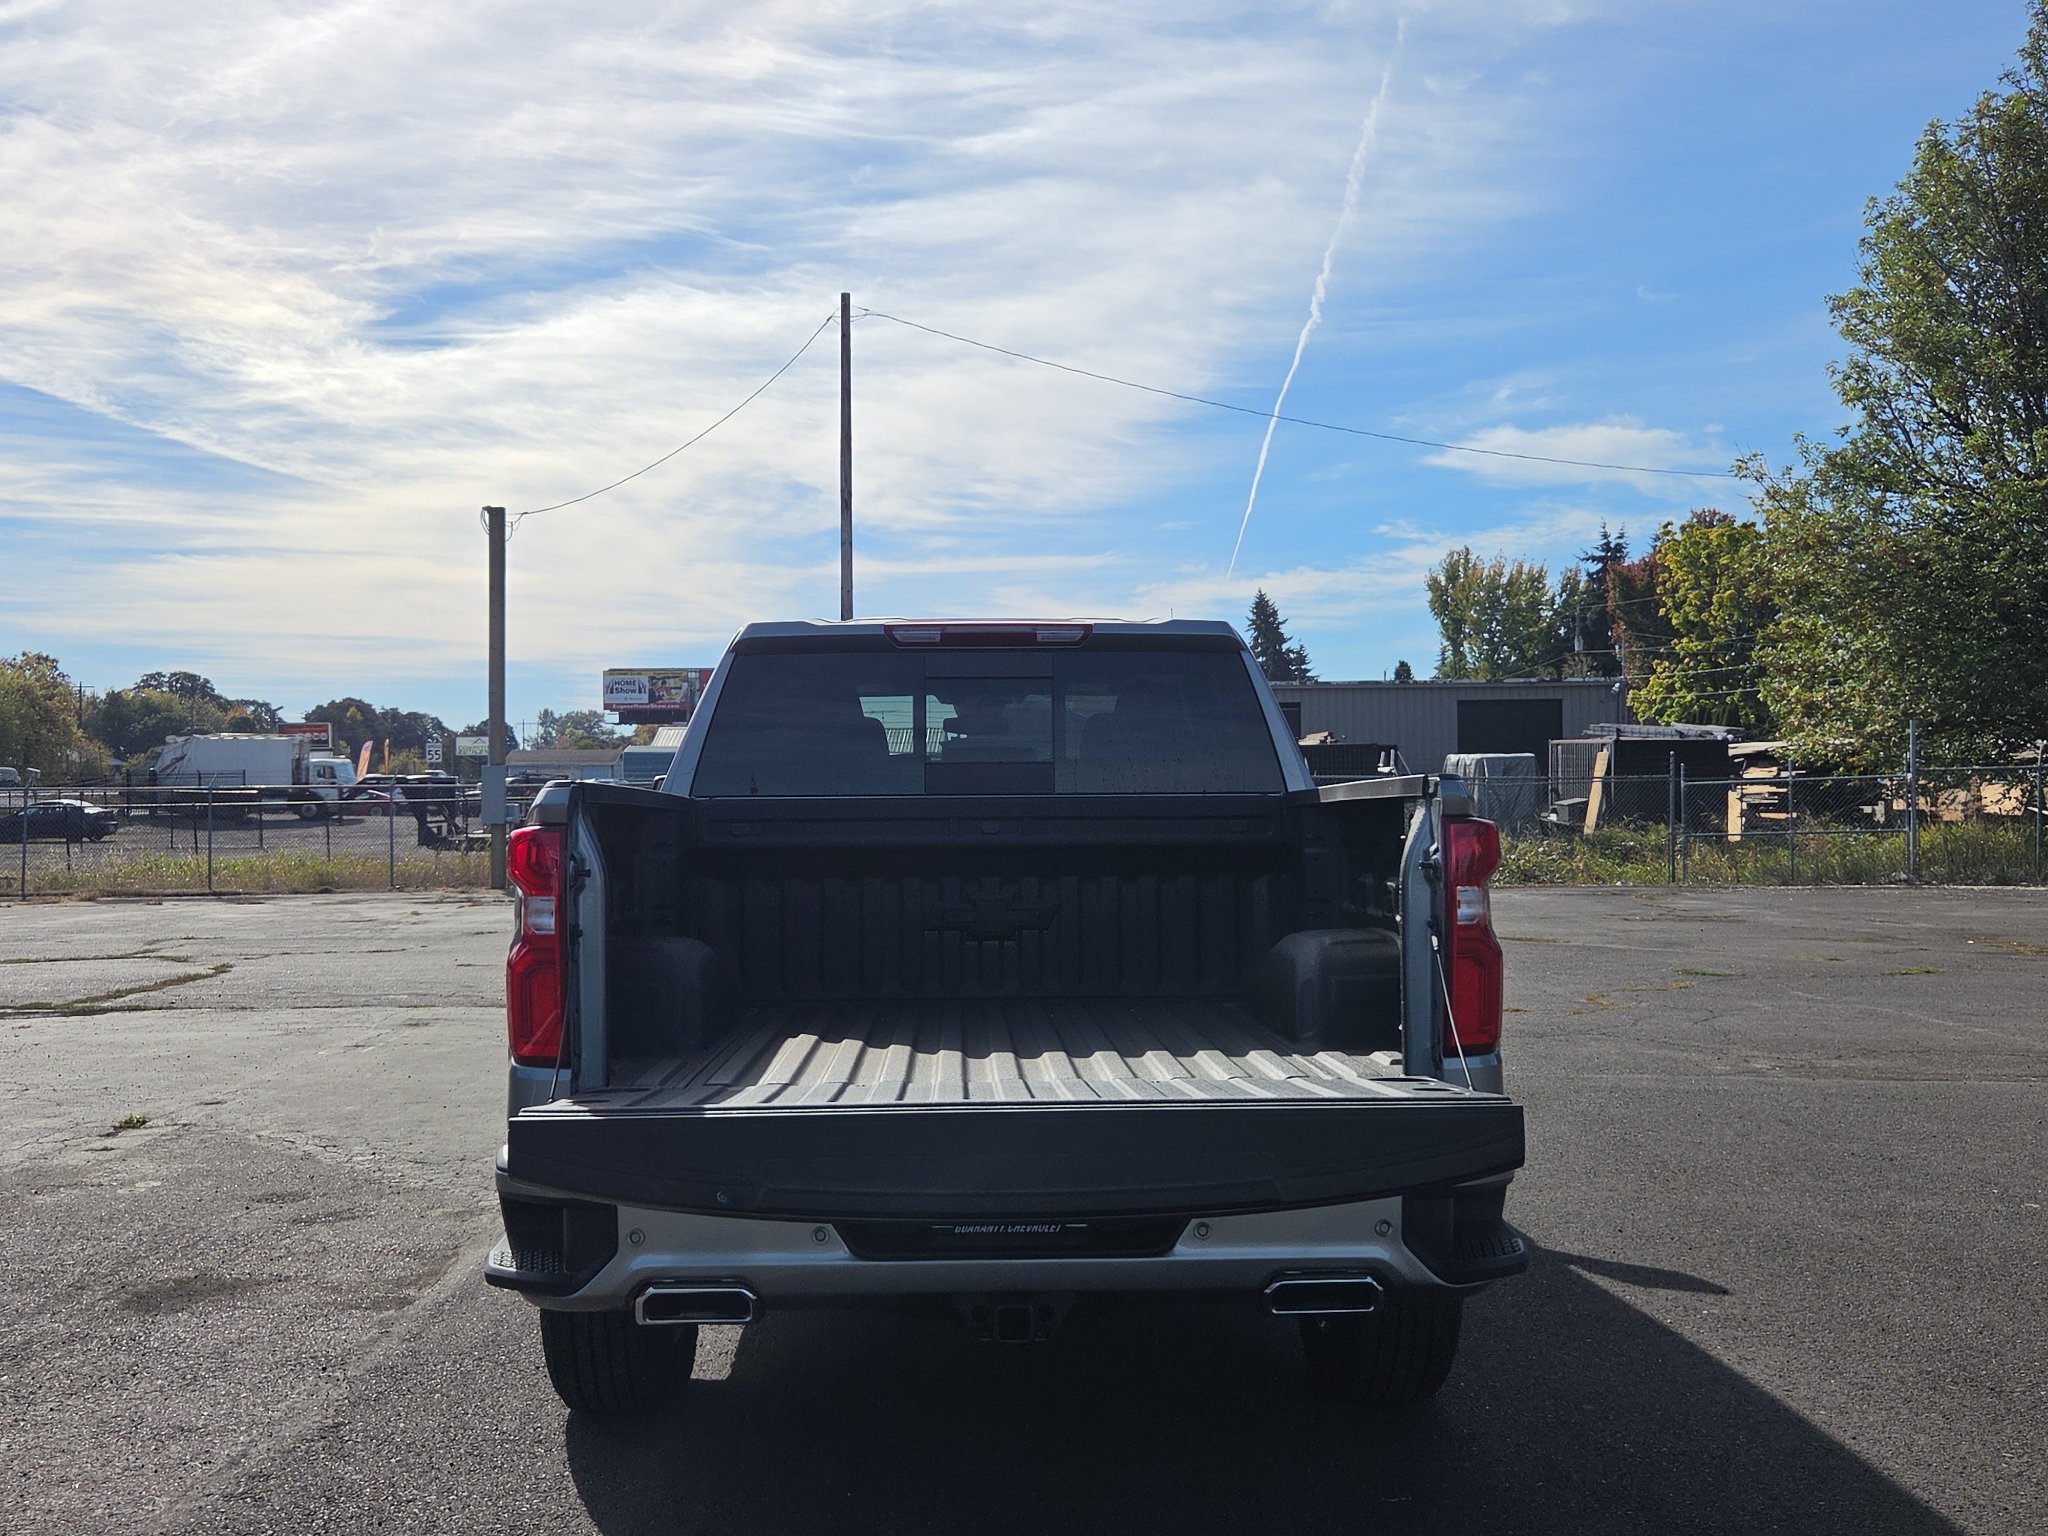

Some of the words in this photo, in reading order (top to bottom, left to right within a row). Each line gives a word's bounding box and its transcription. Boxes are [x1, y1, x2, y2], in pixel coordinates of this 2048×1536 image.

[614, 679, 637, 687] HOME
[614, 687, 637, 695] Show
[427, 749, 441, 760] 55
